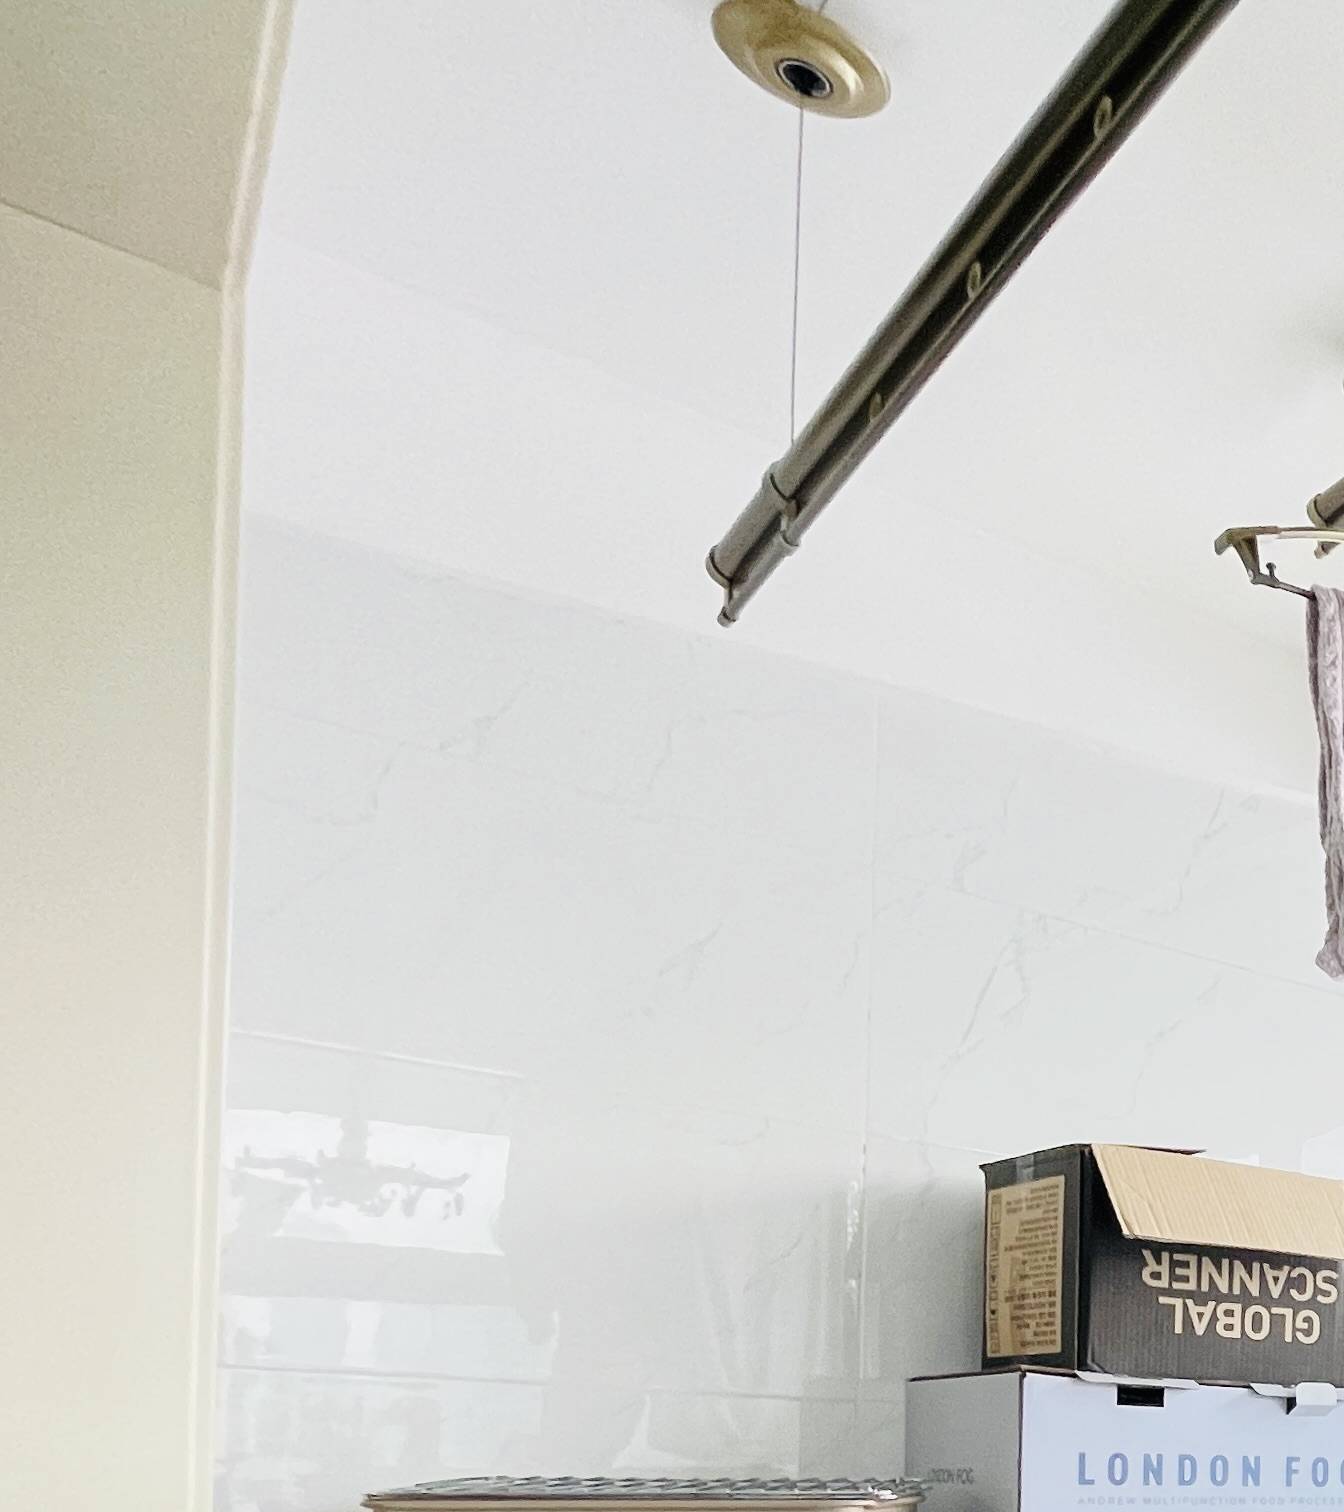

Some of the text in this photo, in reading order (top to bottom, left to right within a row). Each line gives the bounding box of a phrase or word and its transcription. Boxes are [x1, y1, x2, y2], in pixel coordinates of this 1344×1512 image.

[1141, 1248, 1339, 1304] SCANNER
[1158, 1296, 1321, 1345] GLOBAL
[1078, 1451, 1262, 1487] LONDON
